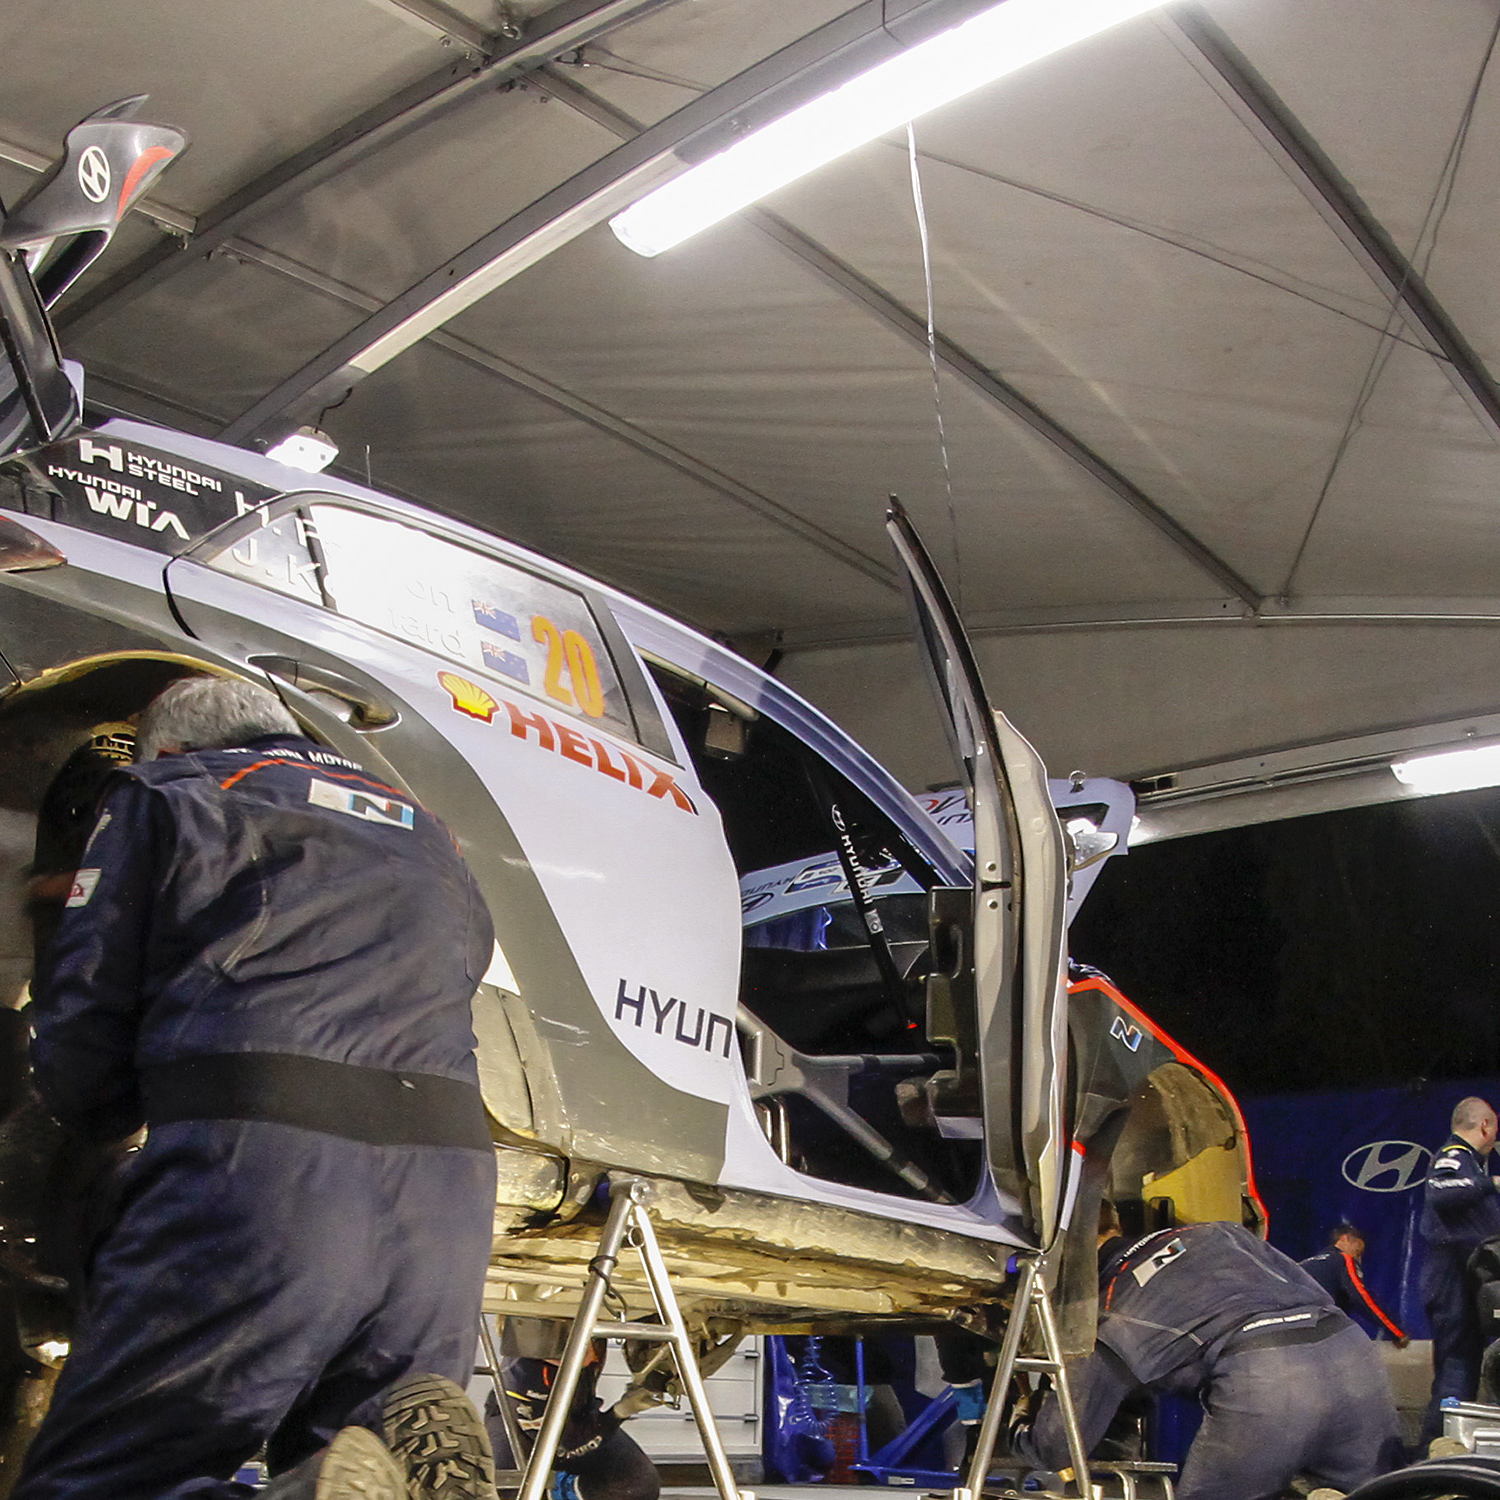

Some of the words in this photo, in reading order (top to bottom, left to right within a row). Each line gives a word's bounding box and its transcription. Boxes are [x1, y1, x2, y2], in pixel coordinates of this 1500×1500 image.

[48, 465, 141, 500] HYUNDAI
[127, 451, 222, 492] HYUNDAI
[128, 464, 198, 496] STEEL
[84, 486, 190, 541] WIA
[531, 614, 605, 719] 20
[502, 698, 698, 816] HELIX
[841, 834, 874, 905] HYUNDAI
[614, 978, 733, 1059] HYUN
